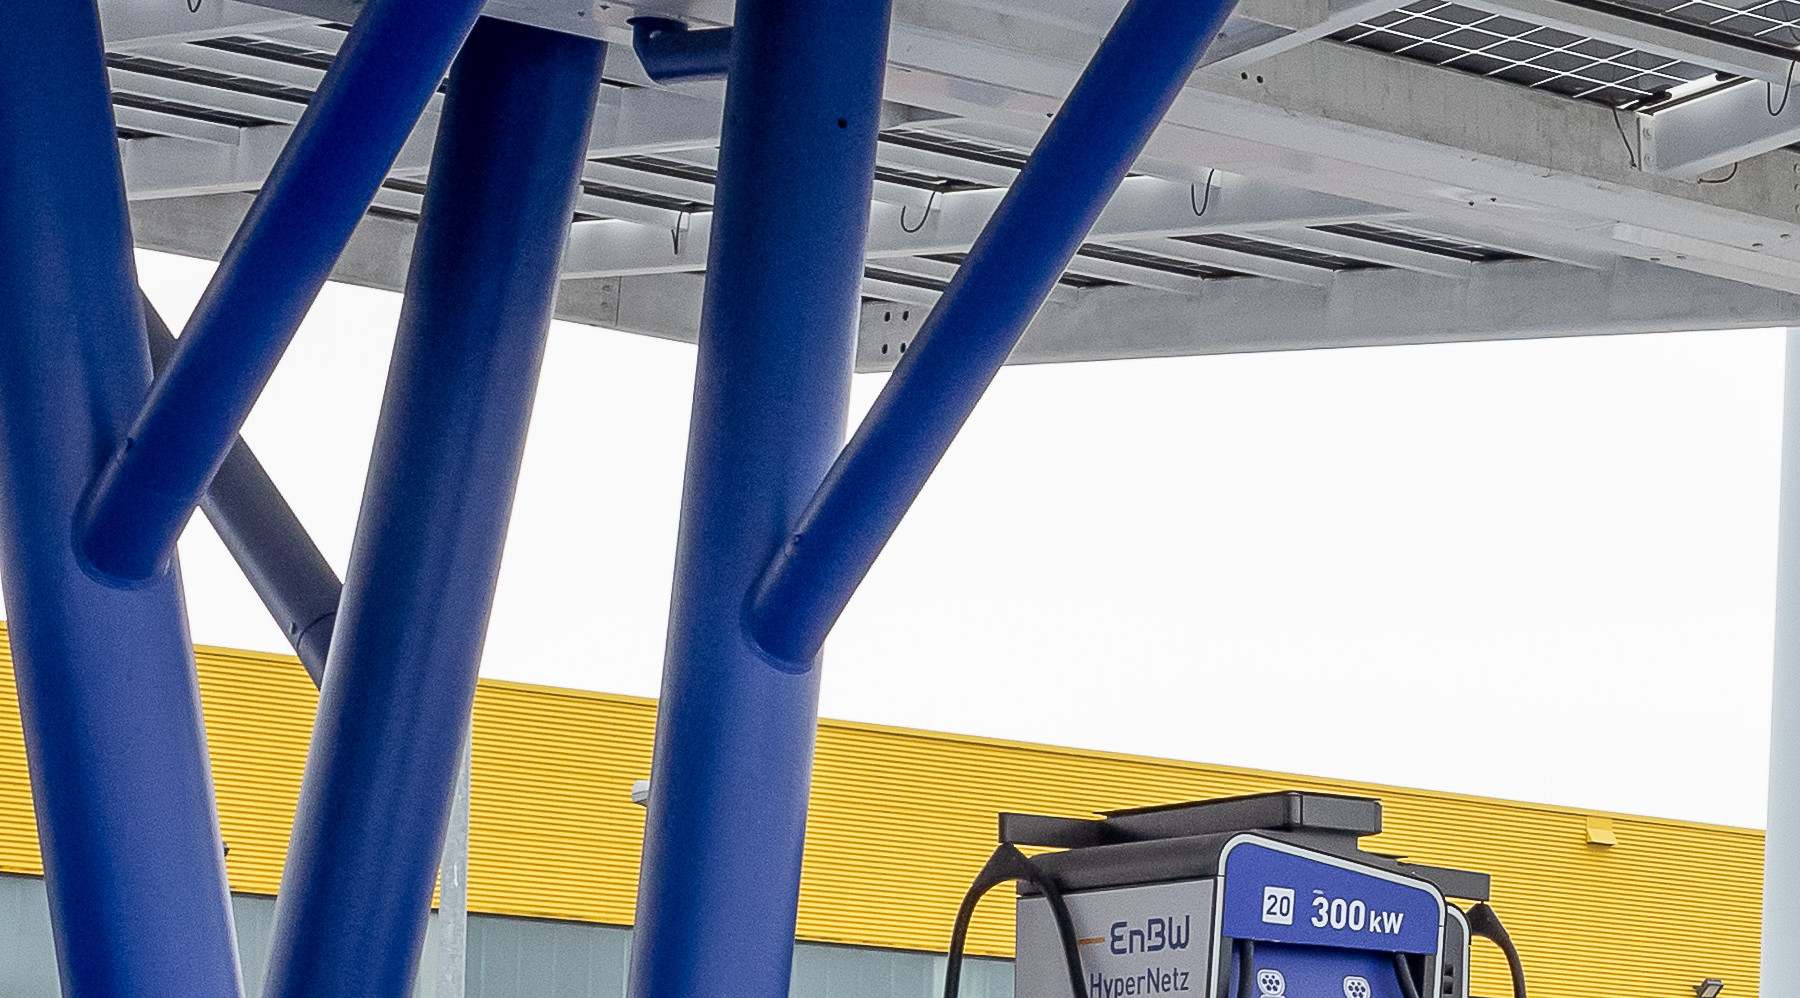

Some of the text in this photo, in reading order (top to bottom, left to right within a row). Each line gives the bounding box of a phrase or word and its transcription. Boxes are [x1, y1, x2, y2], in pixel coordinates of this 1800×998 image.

[1110, 914, 1191, 956] EnBW
[1266, 894, 1404, 935] 20 300 kW
